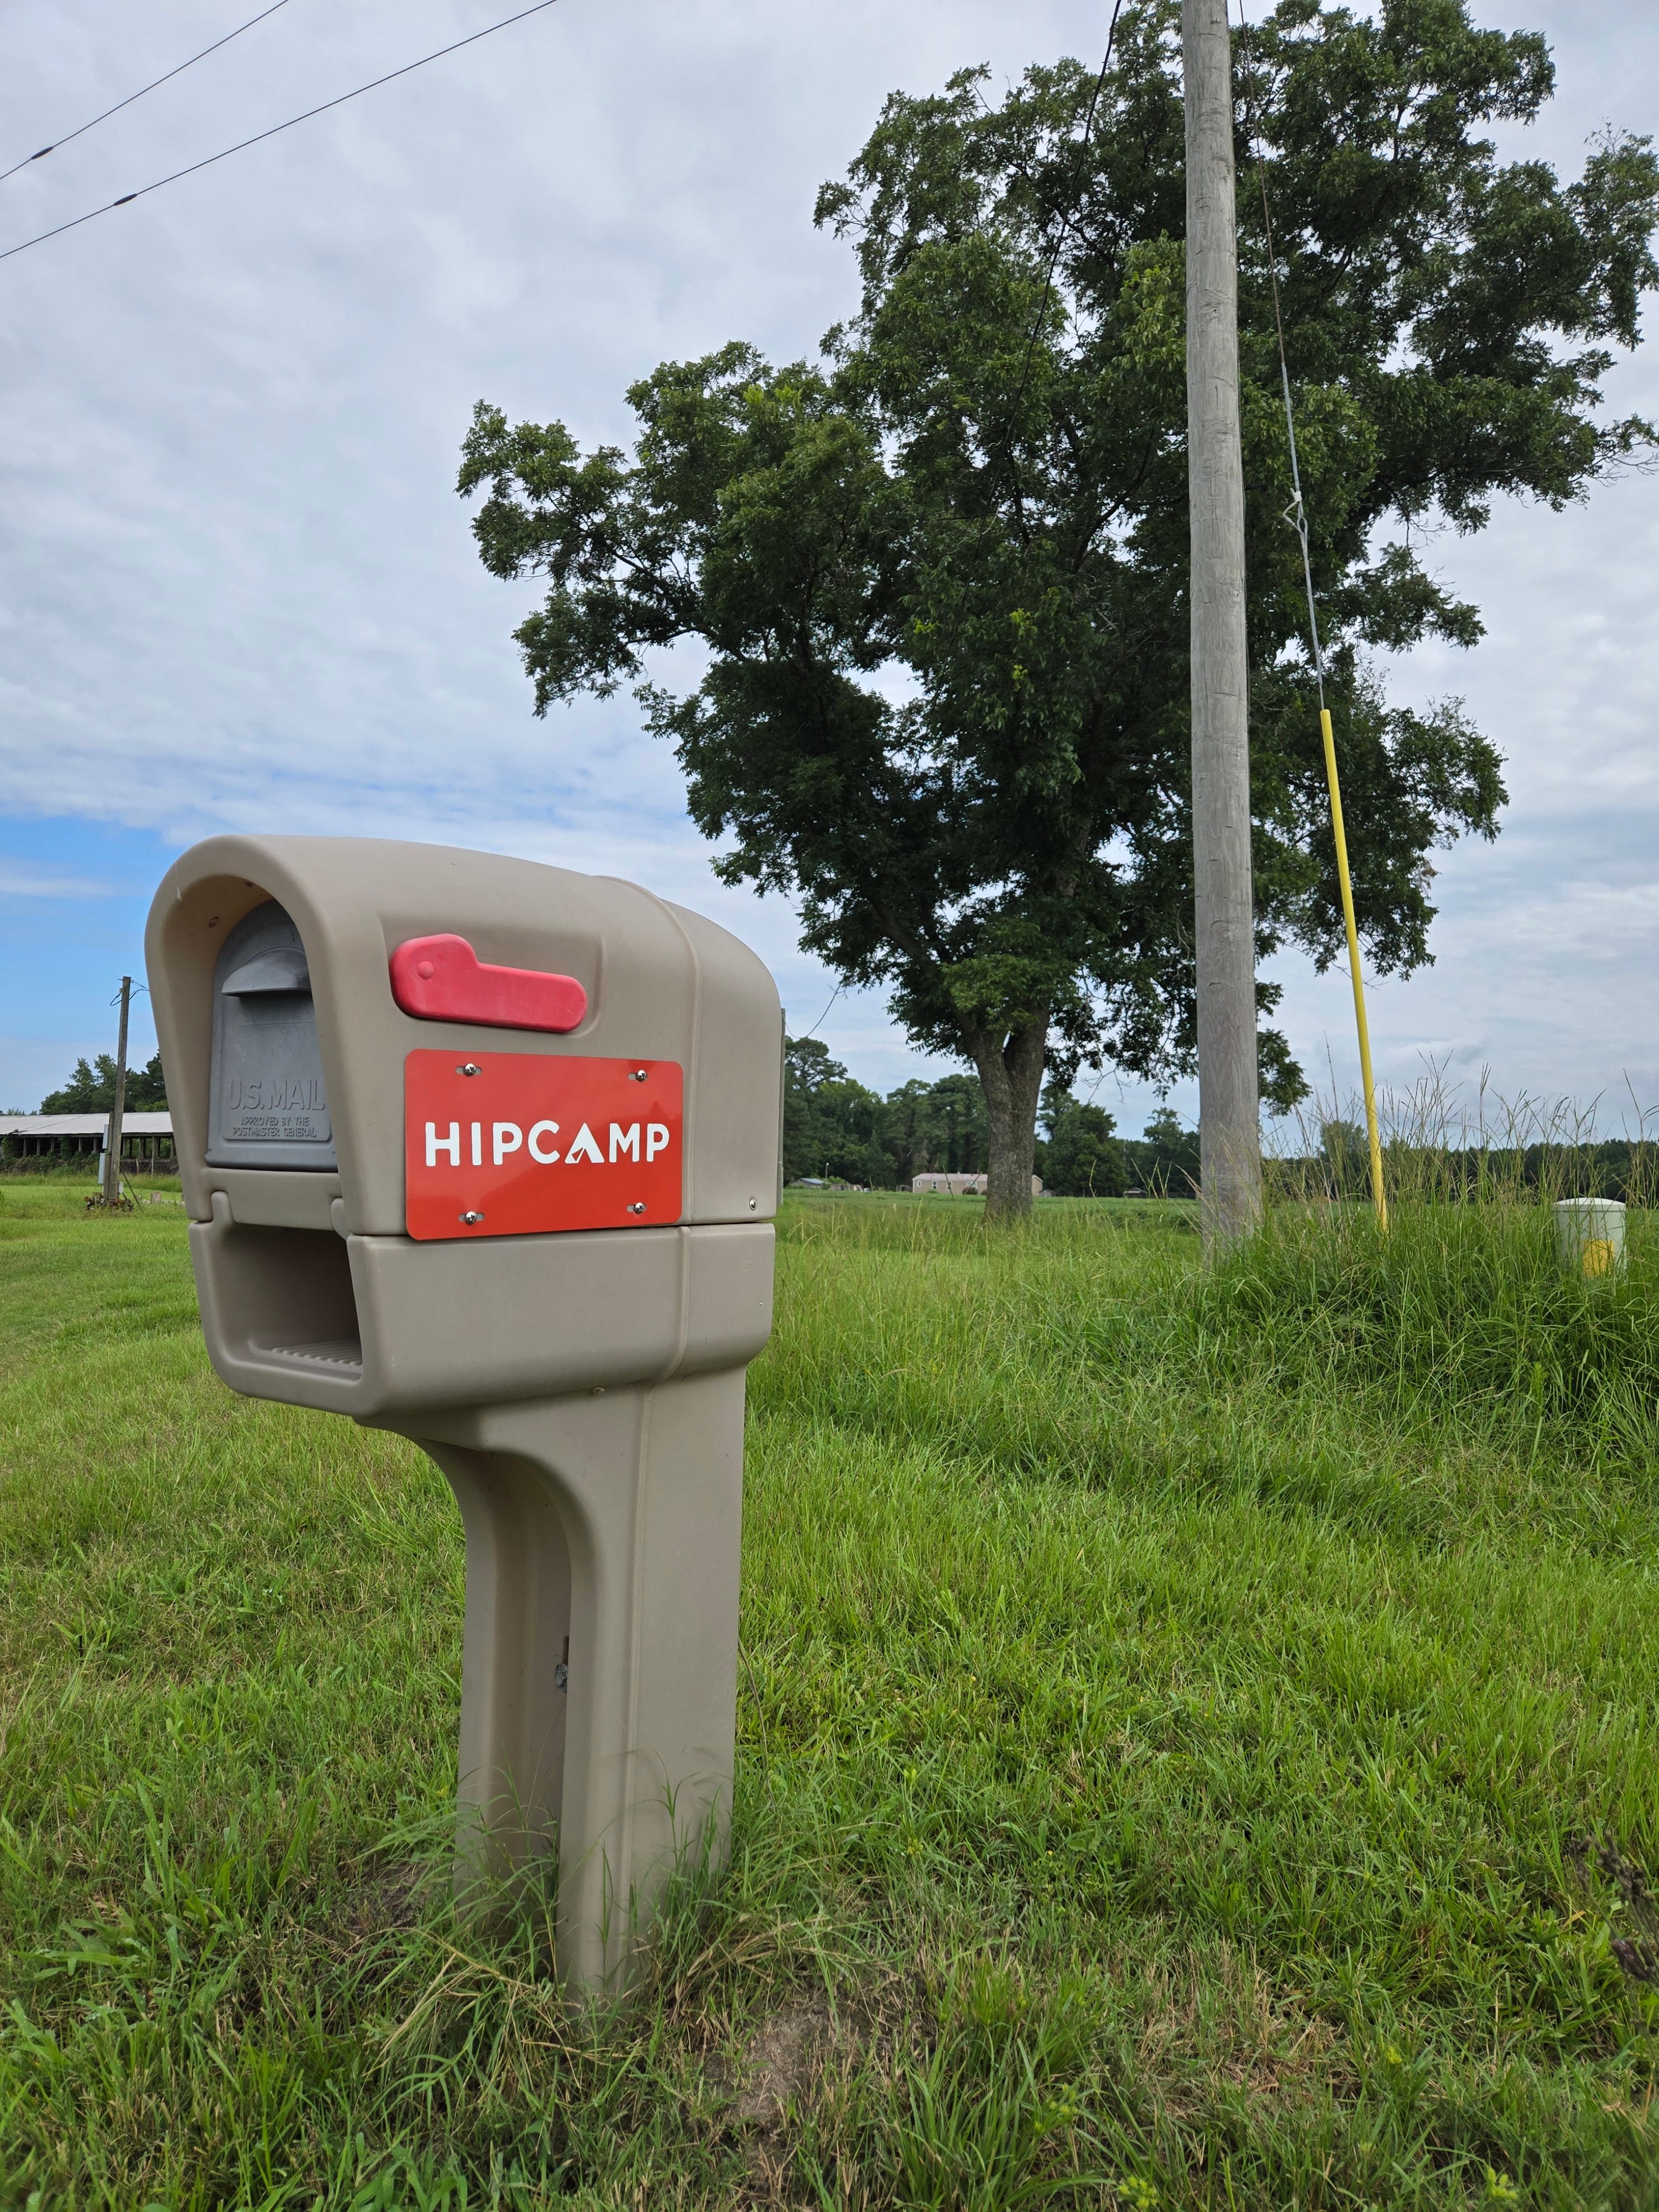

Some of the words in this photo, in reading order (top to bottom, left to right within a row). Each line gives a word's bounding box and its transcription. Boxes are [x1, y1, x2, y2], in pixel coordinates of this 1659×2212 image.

[229, 1079, 265, 1109] U.S.
[267, 1079, 325, 1110] MAIL
[241, 1116, 279, 1126] APPROVED
[281, 1116, 291, 1126] BY
[294, 1116, 309, 1126] THE
[233, 1127, 280, 1136] POSTMASTER
[283, 1128, 317, 1138] GENERAL
[425, 1120, 670, 1167] HIPCAMP
